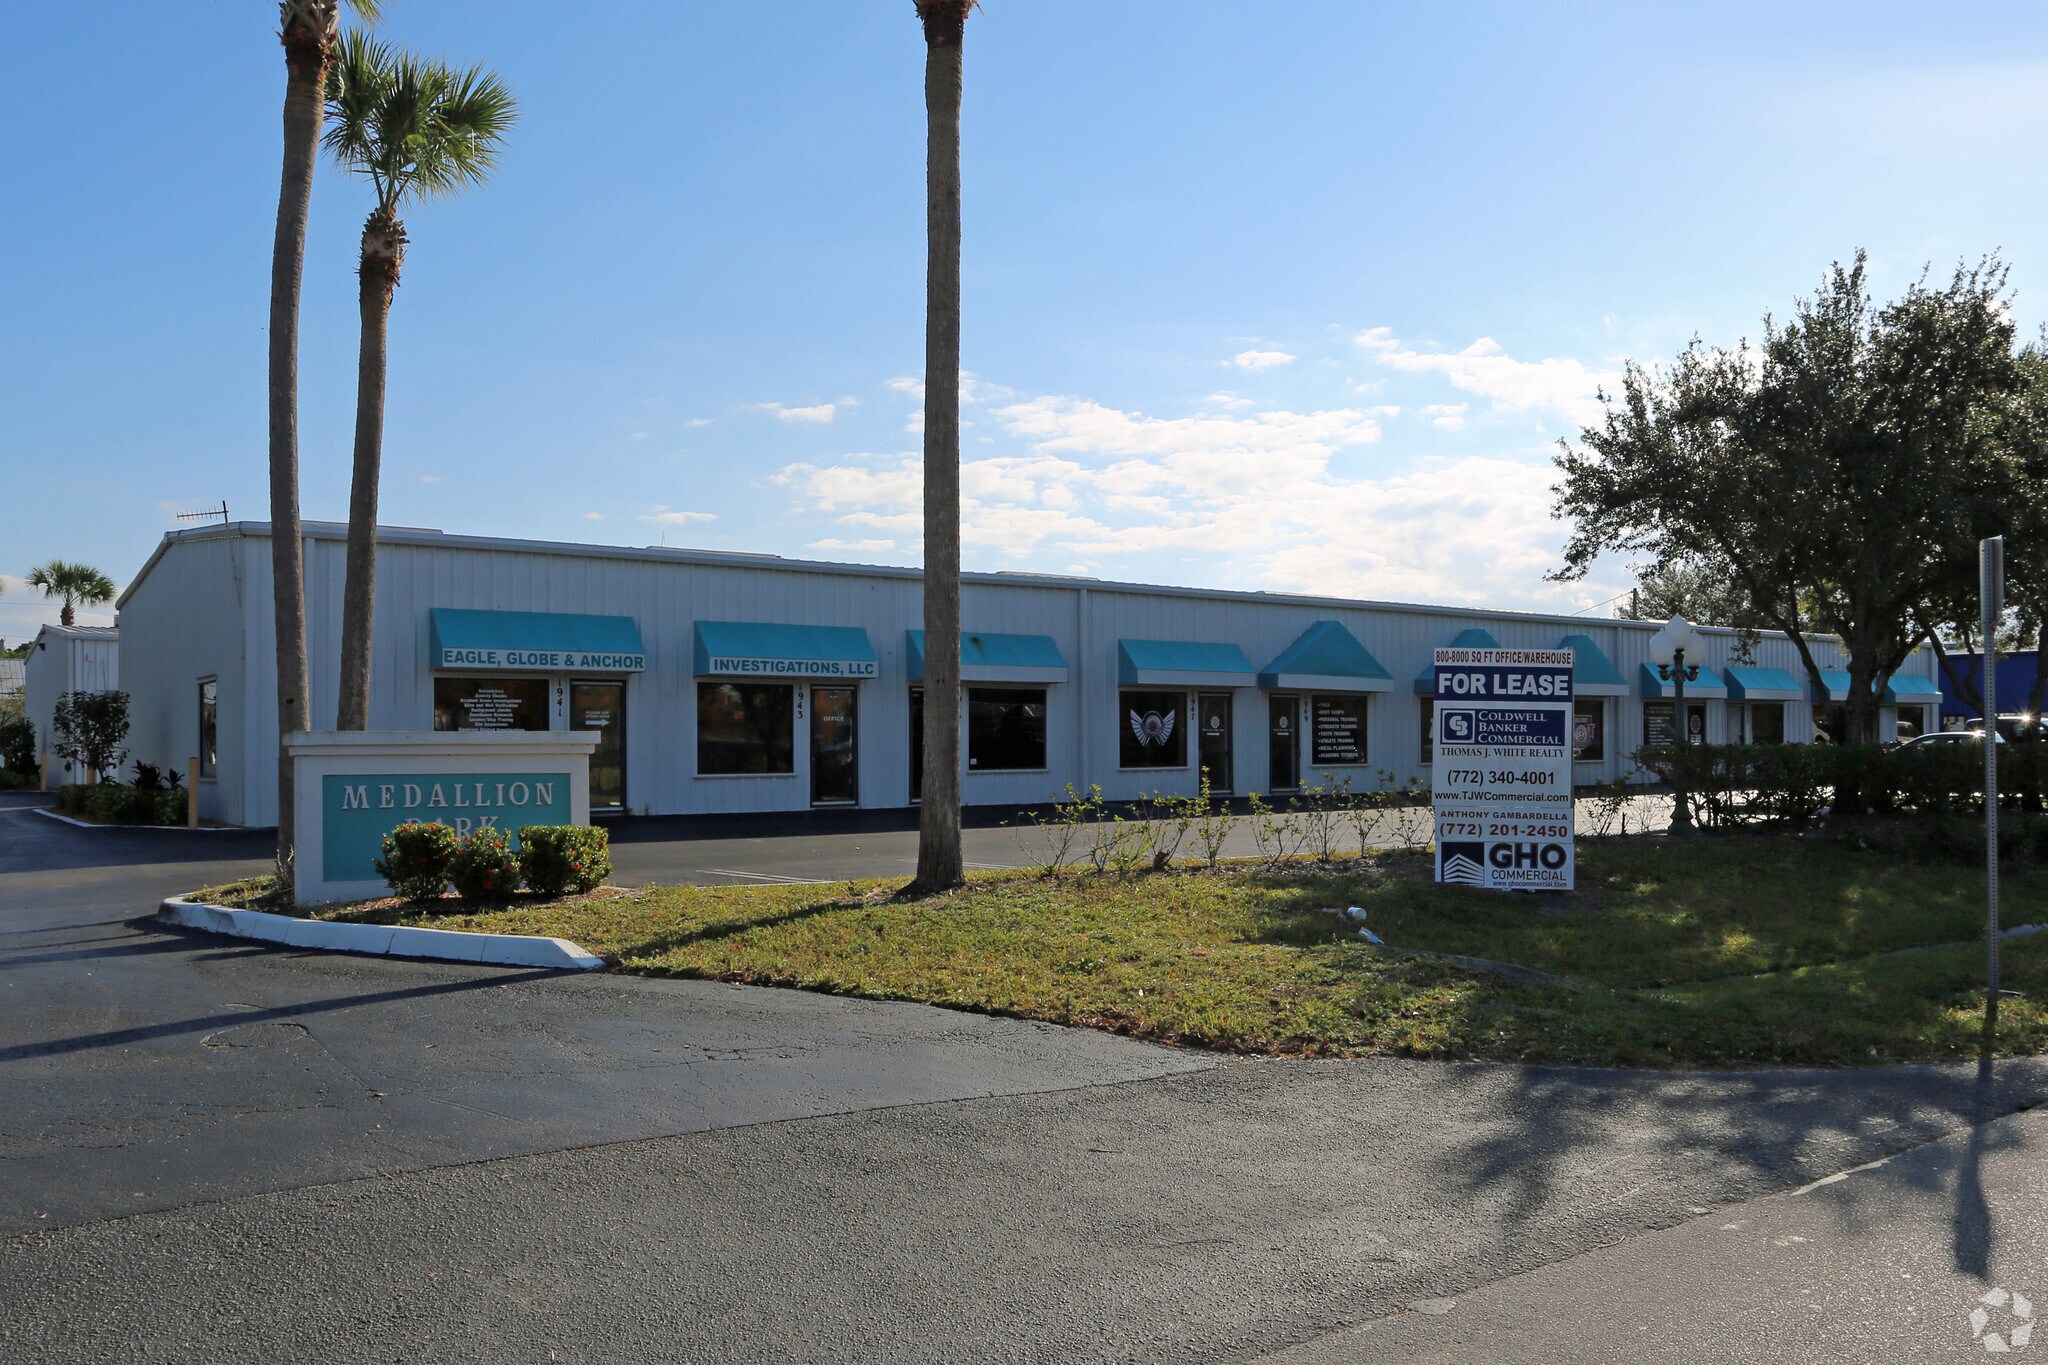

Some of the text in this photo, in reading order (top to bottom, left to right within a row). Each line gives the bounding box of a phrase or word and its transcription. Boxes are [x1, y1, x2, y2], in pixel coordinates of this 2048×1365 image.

[443, 650, 644, 669] EAGLE, GLOBE & ANCHOR
[1435, 650, 1469, 662] 800-8000
[1471, 651, 1482, 664] SQ
[1484, 651, 1493, 663] FT
[714, 659, 874, 676] INVESTIGATIONS, LLC
[1438, 673, 1569, 696] FOR LEASE
[1478, 711, 1548, 722] COLDWELL
[1478, 722, 1528, 733] BANKER
[1478, 733, 1562, 745] COMMERCIAL
[1441, 747, 1565, 758] THOMAS J. WHITE REALTY
[1447, 769, 1555, 786] (772) 340-4001
[341, 782, 555, 810] MEDALLION
[1435, 791, 1569, 802] www.TJWCommercial.com
[1440, 810, 1568, 821] ANTHONY GAMBARDELLA
[1440, 823, 1568, 838] (772) 201-2450
[1488, 842, 1567, 870] GHO
[1491, 869, 1567, 881] COMMERCIAL
[1493, 880, 1567, 888] www.ghocommercial.com
